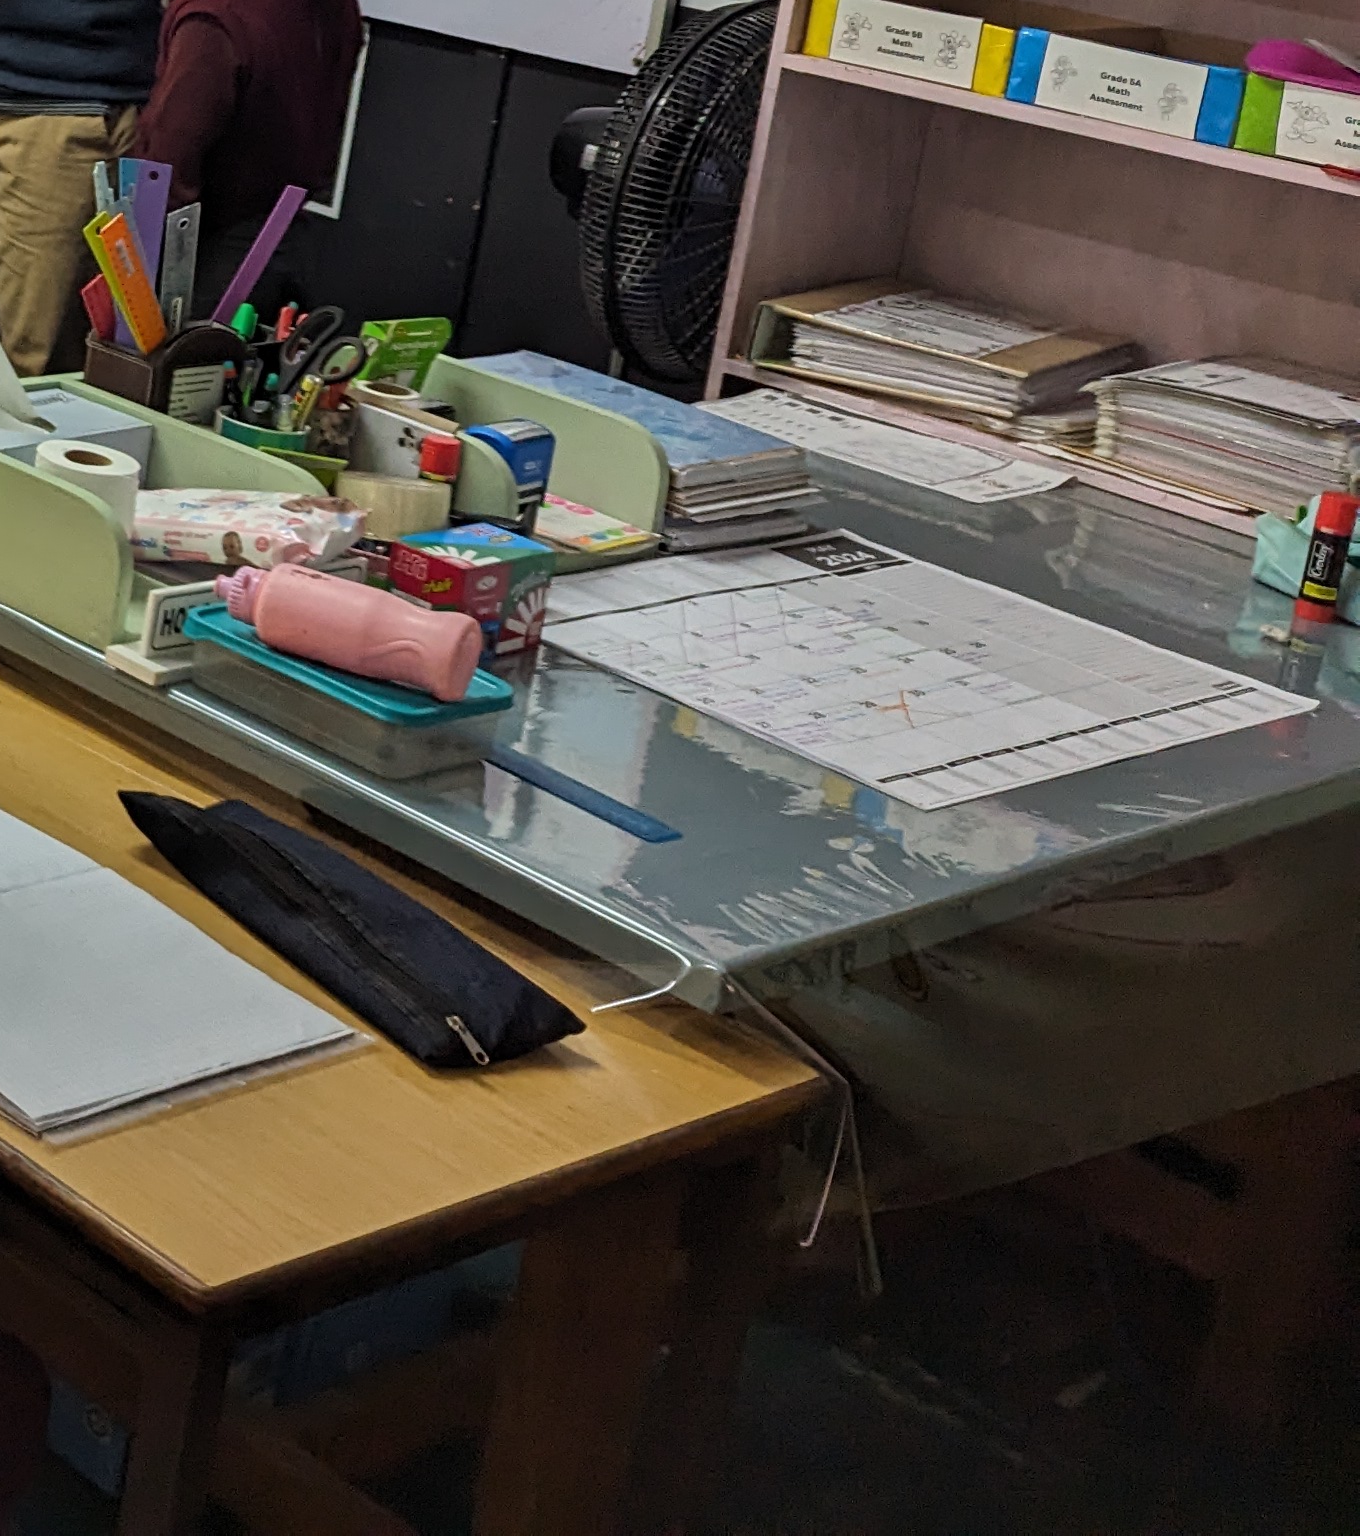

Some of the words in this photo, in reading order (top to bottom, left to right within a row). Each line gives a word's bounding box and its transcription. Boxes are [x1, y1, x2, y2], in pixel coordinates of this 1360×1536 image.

[892, 38, 913, 49] Math
[1107, 85, 1130, 97] Math
[1089, 92, 1143, 112] Assessment
[816, 550, 877, 566] 2024
